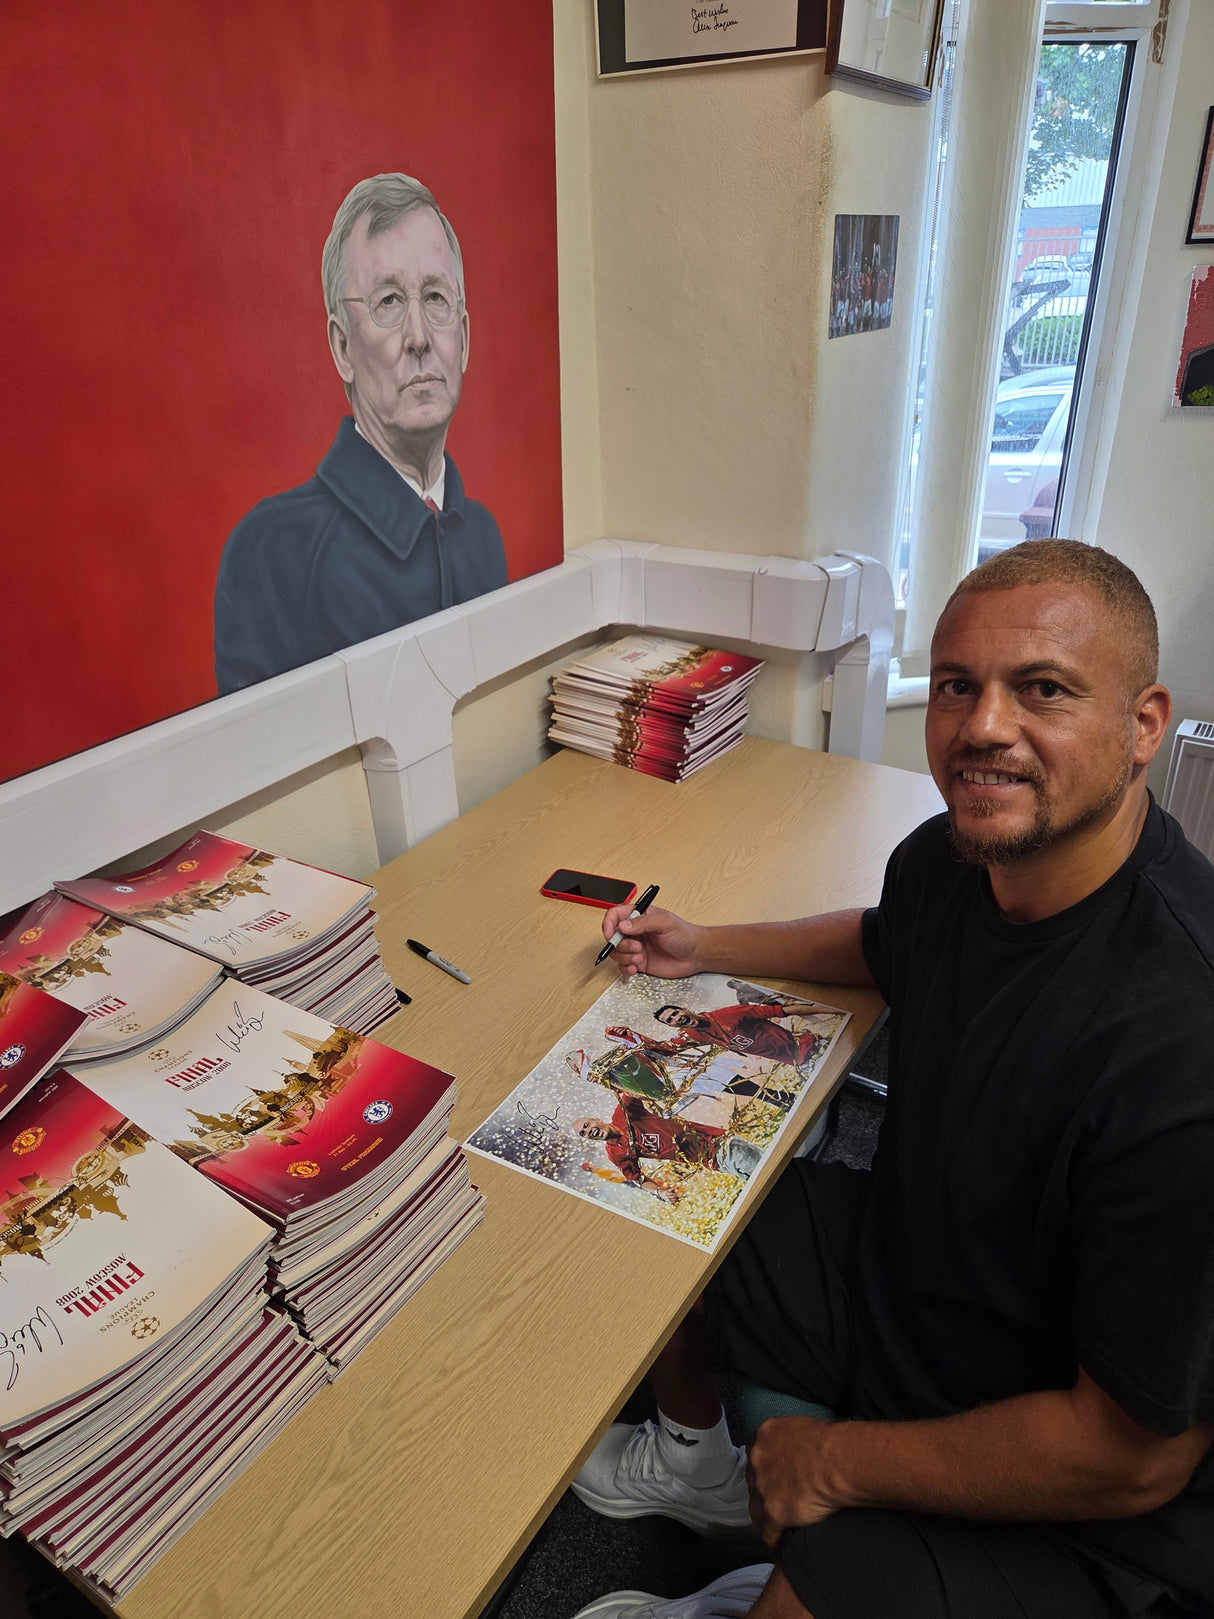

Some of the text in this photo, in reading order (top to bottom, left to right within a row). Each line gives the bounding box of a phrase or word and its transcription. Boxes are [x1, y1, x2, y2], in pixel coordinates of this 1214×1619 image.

[164, 1057, 224, 1088] FINAL
[55, 1252, 126, 1307] MOSCOW 2008
[63, 1261, 145, 1318] FINAL
[99, 1290, 155, 1333] CHAMPIONS
